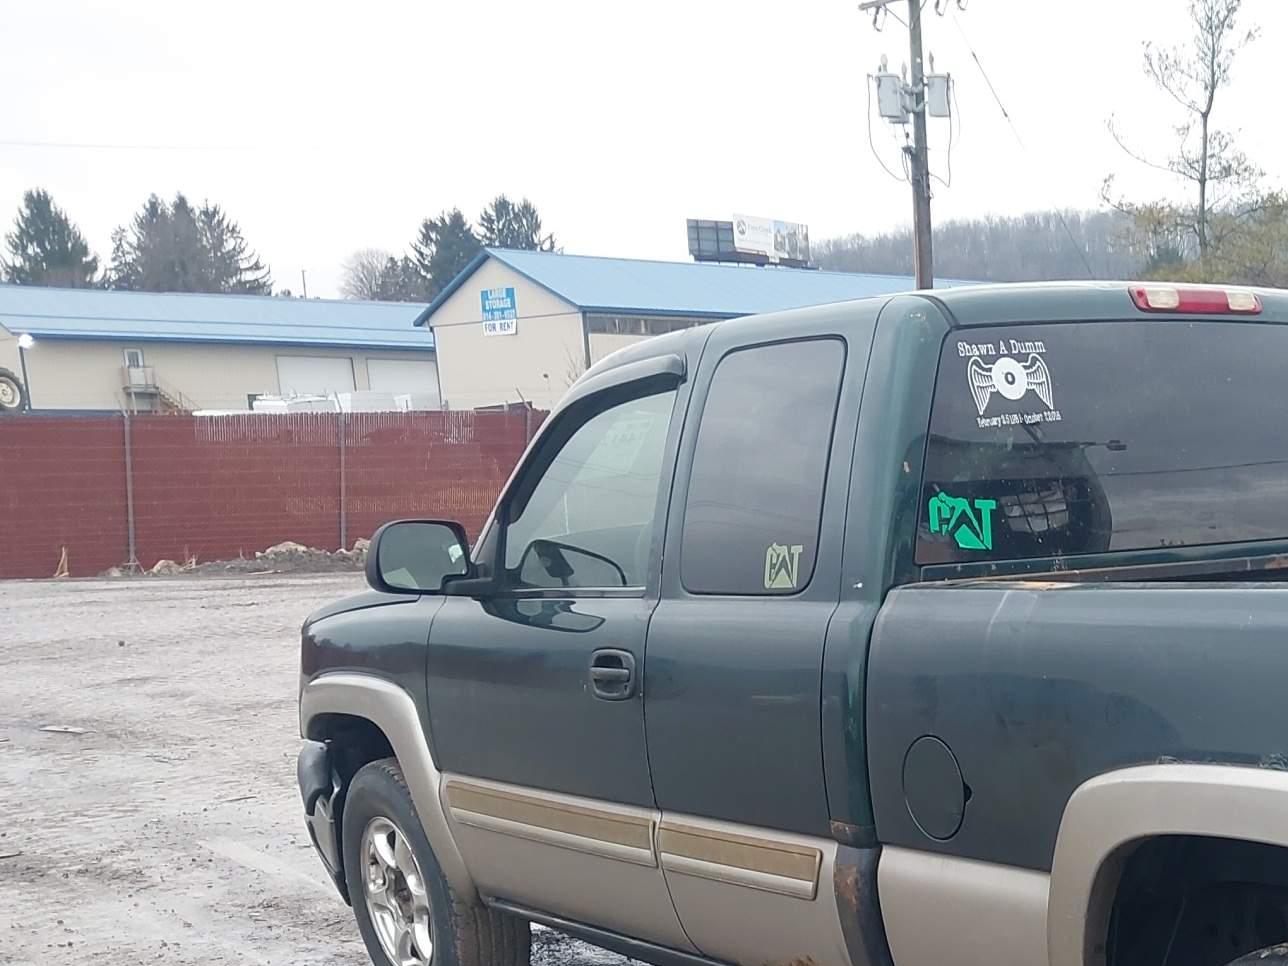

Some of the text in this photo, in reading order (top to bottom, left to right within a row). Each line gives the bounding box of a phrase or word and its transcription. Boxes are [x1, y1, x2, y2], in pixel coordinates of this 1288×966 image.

[485, 298, 511, 310] STORAGE
[484, 321, 514, 333] FOR RENT
[957, 341, 996, 356] Shawn
[999, 340, 1009, 354] A
